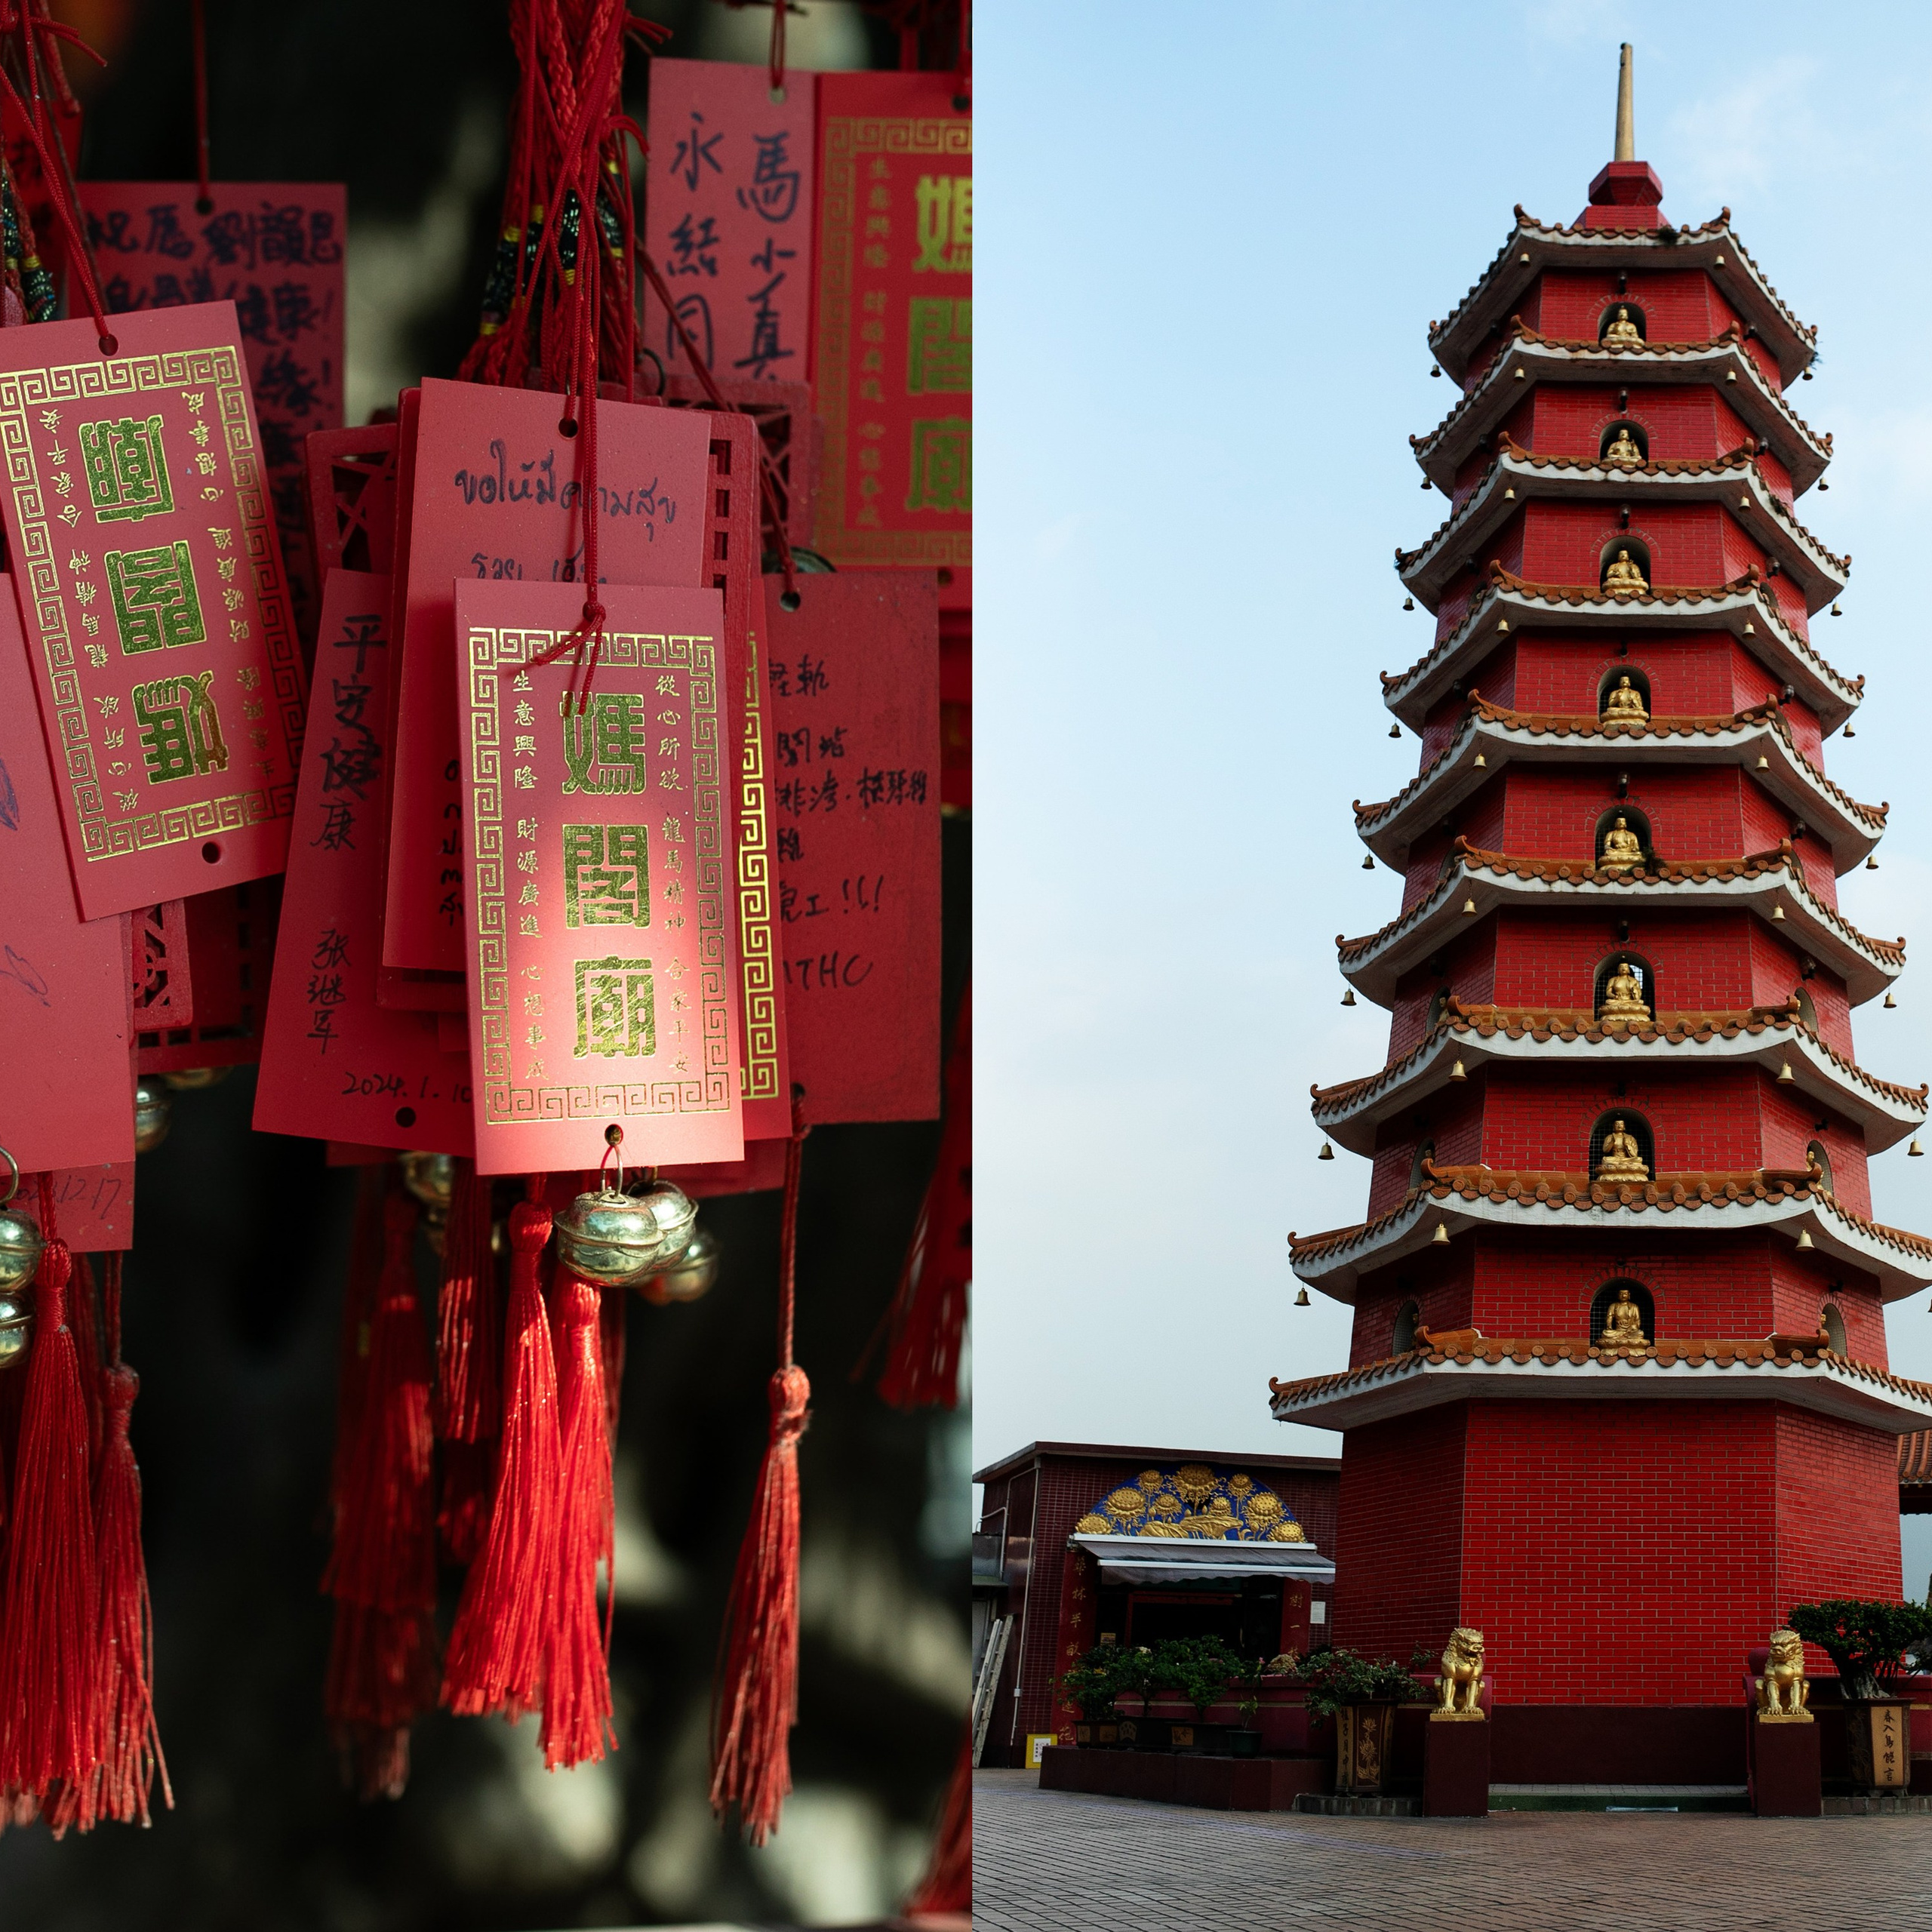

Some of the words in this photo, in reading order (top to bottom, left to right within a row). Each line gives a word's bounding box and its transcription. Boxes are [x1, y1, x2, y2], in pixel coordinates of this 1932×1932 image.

[39, 408, 84, 527] 合家平安
[181, 391, 225, 503] 心想事成
[68, 549, 109, 669] 龍馬精神
[78, 414, 230, 785] 媽閣廟
[208, 527, 251, 643] 財源廣進
[94, 694, 140, 813] 從心所欲
[310, 614, 387, 851] 平安健康
[512, 669, 539, 790] 生意興隆
[654, 675, 684, 792] 從心所欲
[516, 817, 543, 939] 財源廣進
[559, 690, 657, 1060] 媽閣廟
[661, 817, 688, 934] 龍馬精神
[521, 964, 549, 1081] 心想事成
[664, 956, 692, 1074] 合家平安
